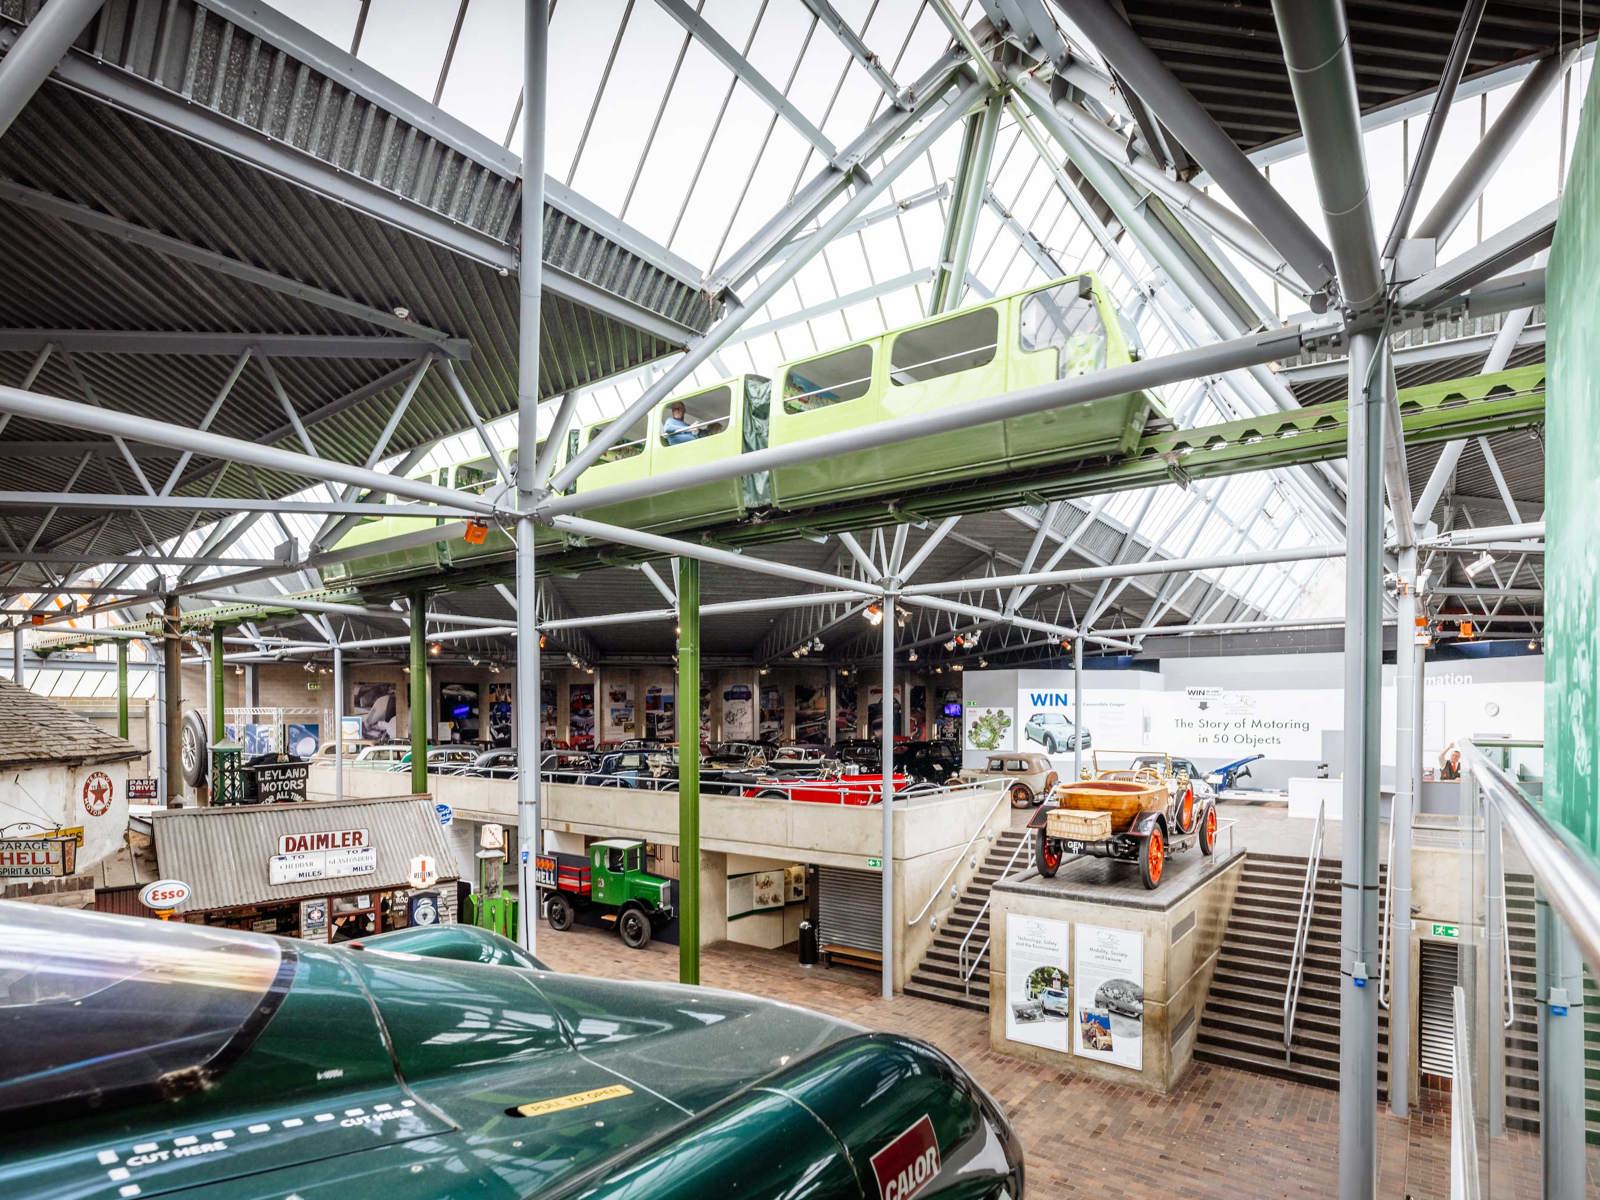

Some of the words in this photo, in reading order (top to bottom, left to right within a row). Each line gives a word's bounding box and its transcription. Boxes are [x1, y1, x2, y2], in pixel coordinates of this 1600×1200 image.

[1424, 673, 1473, 686] mation
[1030, 692, 1068, 707] WIN
[1174, 718, 1194, 729] The
[1198, 718, 1230, 732] Story
[1234, 718, 1247, 729] of
[1251, 719, 1310, 732] Motoring
[1198, 733, 1209, 744] in
[1213, 734, 1230, 744] 50
[1233, 734, 1281, 748] Objects
[87, 772, 111, 784] TEXACO
[257, 767, 307, 781] LEYLAND
[261, 780, 304, 793] MOTORS
[276, 791, 290, 800] ALL
[84, 797, 102, 816] MOTOR
[0, 842, 49, 851] GARAGE
[285, 831, 364, 853] DAIMLER
[1067, 841, 1084, 850] GEN
[0, 852, 60, 865] HELL
[0, 867, 23, 875] SPIRIT
[24, 867, 30, 875] &
[31, 866, 51, 875] OILS
[298, 871, 322, 879] MILES
[352, 865, 375, 873] MILES
[536, 869, 556, 886] HELL
[566, 1094, 585, 1103] TO
[340, 1115, 373, 1128] CUT
[372, 1108, 415, 1123] HERE
[126, 1150, 170, 1167] CUT
[173, 1141, 228, 1159] HERE
[884, 1145, 939, 1200] CALOR
